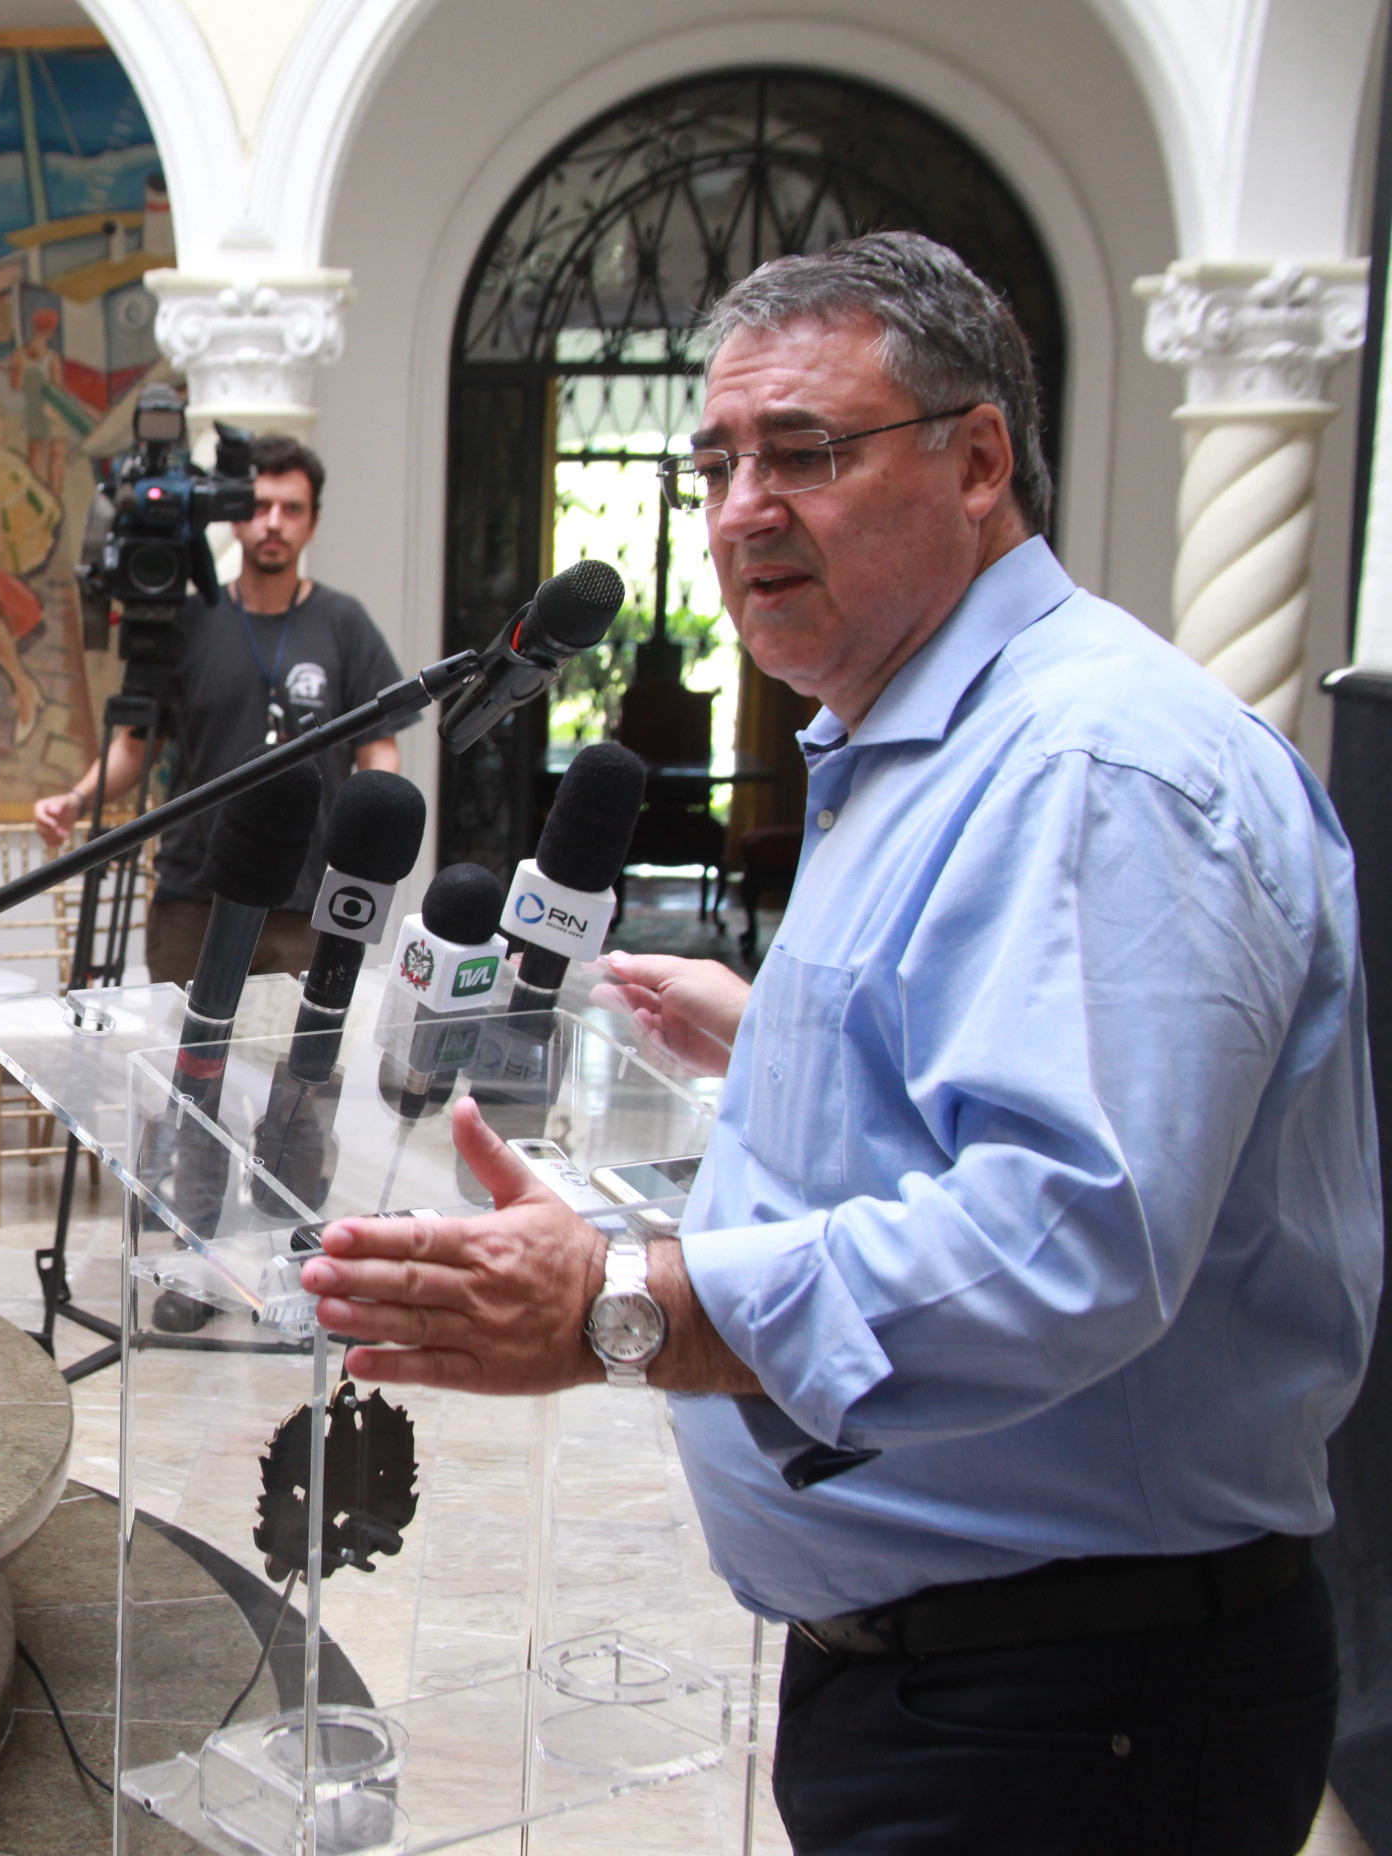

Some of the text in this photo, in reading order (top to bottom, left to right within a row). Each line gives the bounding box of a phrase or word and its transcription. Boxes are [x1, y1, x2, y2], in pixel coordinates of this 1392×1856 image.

[546, 922, 584, 939] RECORD NEWS
[548, 907, 588, 933] RN
